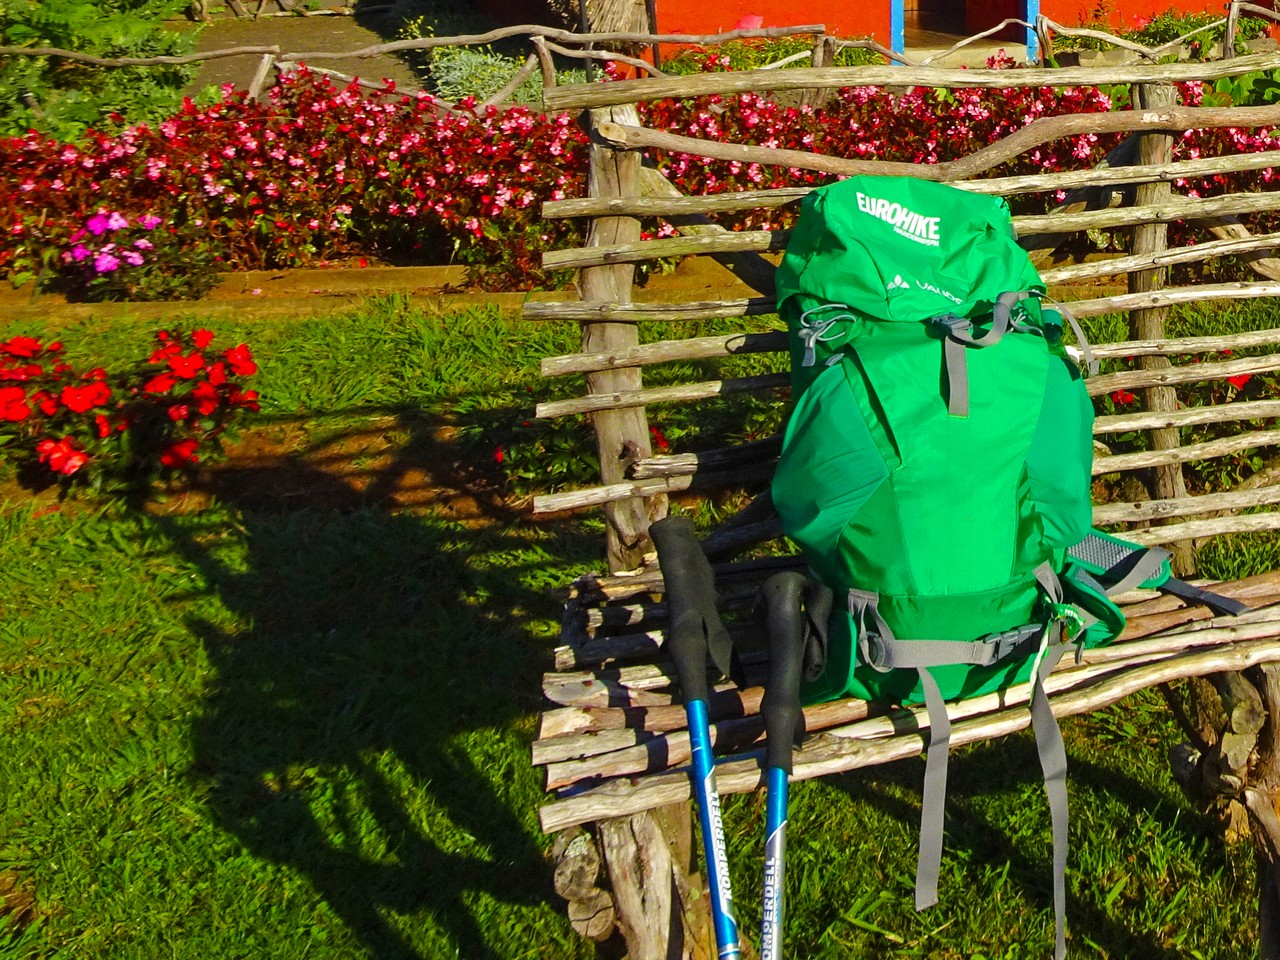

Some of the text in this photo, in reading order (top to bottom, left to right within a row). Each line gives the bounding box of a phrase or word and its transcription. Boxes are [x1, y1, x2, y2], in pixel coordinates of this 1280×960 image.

[856, 192, 941, 239] EUROHIKE
[711, 791, 732, 900] KOMPERDELL
[762, 857, 774, 960] OMPERDELL
